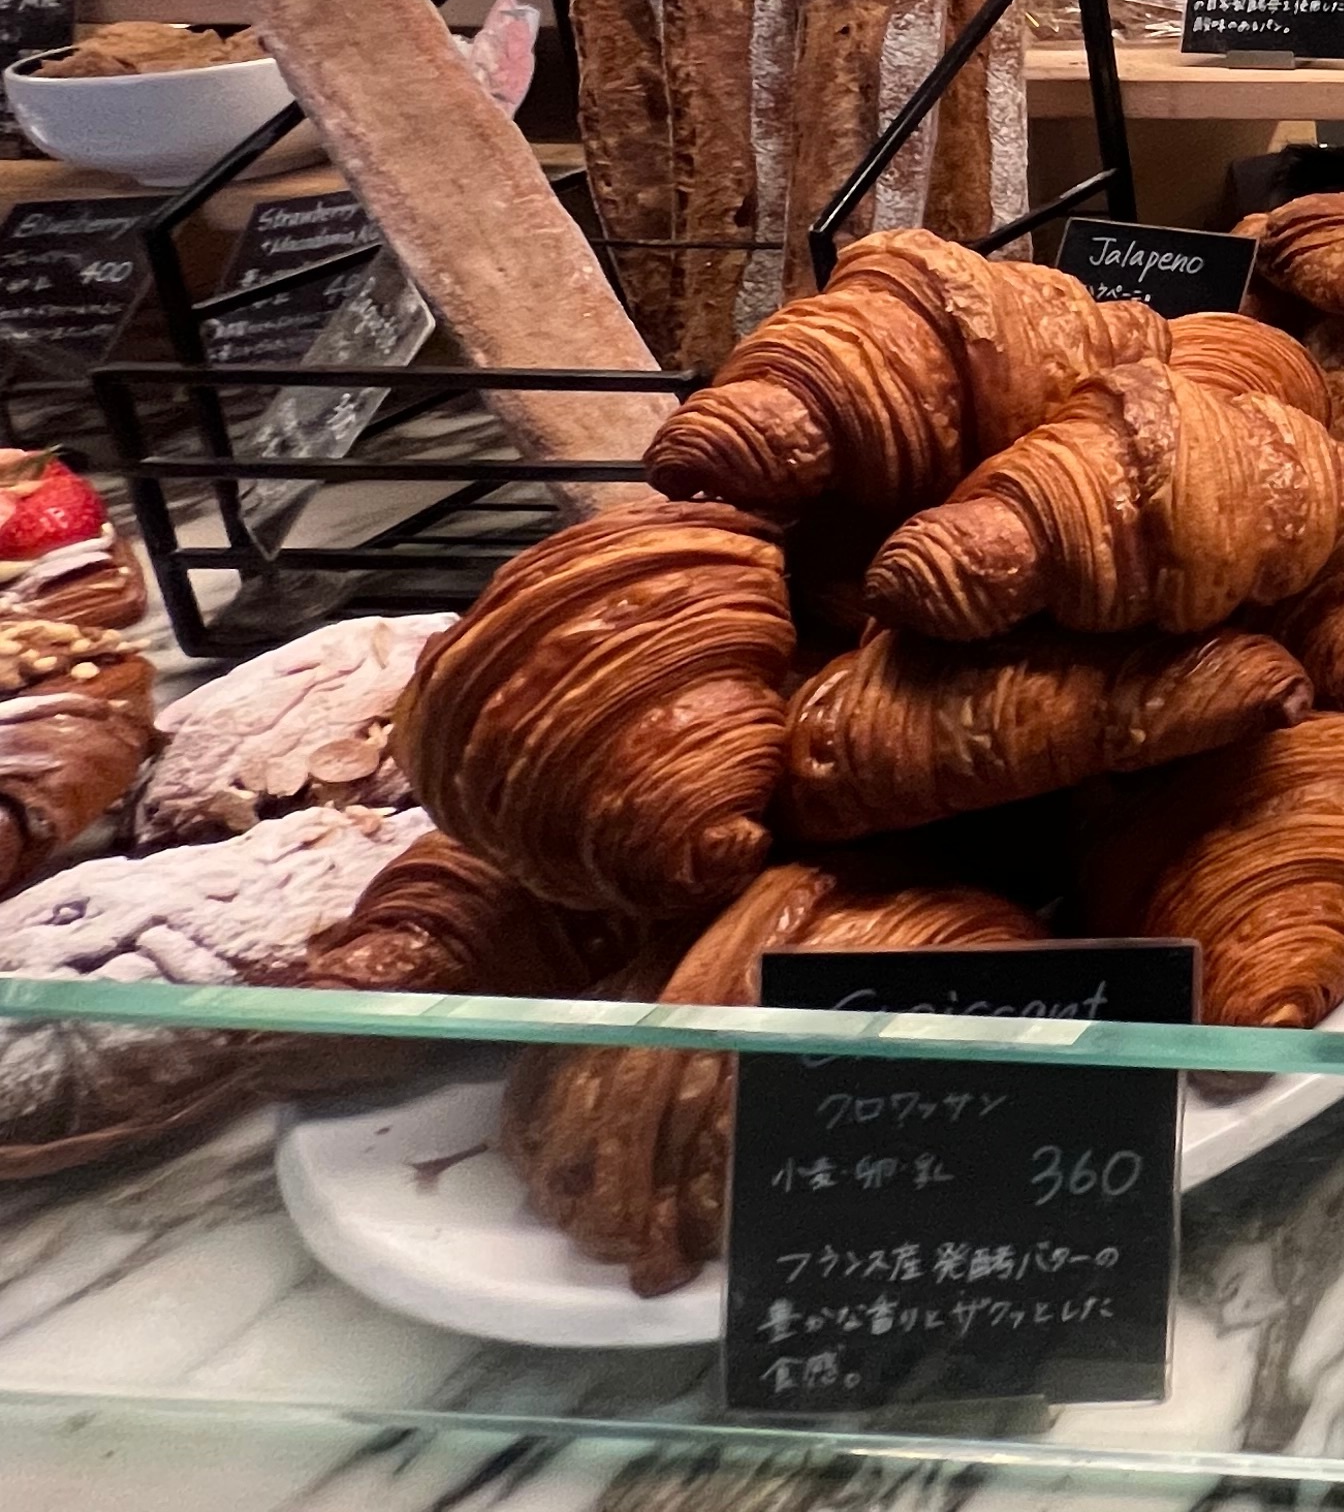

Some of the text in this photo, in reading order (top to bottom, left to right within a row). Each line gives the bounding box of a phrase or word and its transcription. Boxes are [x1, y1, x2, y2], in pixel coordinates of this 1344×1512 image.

[80, 261, 134, 285] 400
[1089, 237, 1205, 283] Jalapeno
[1031, 1144, 1143, 1206] 360
